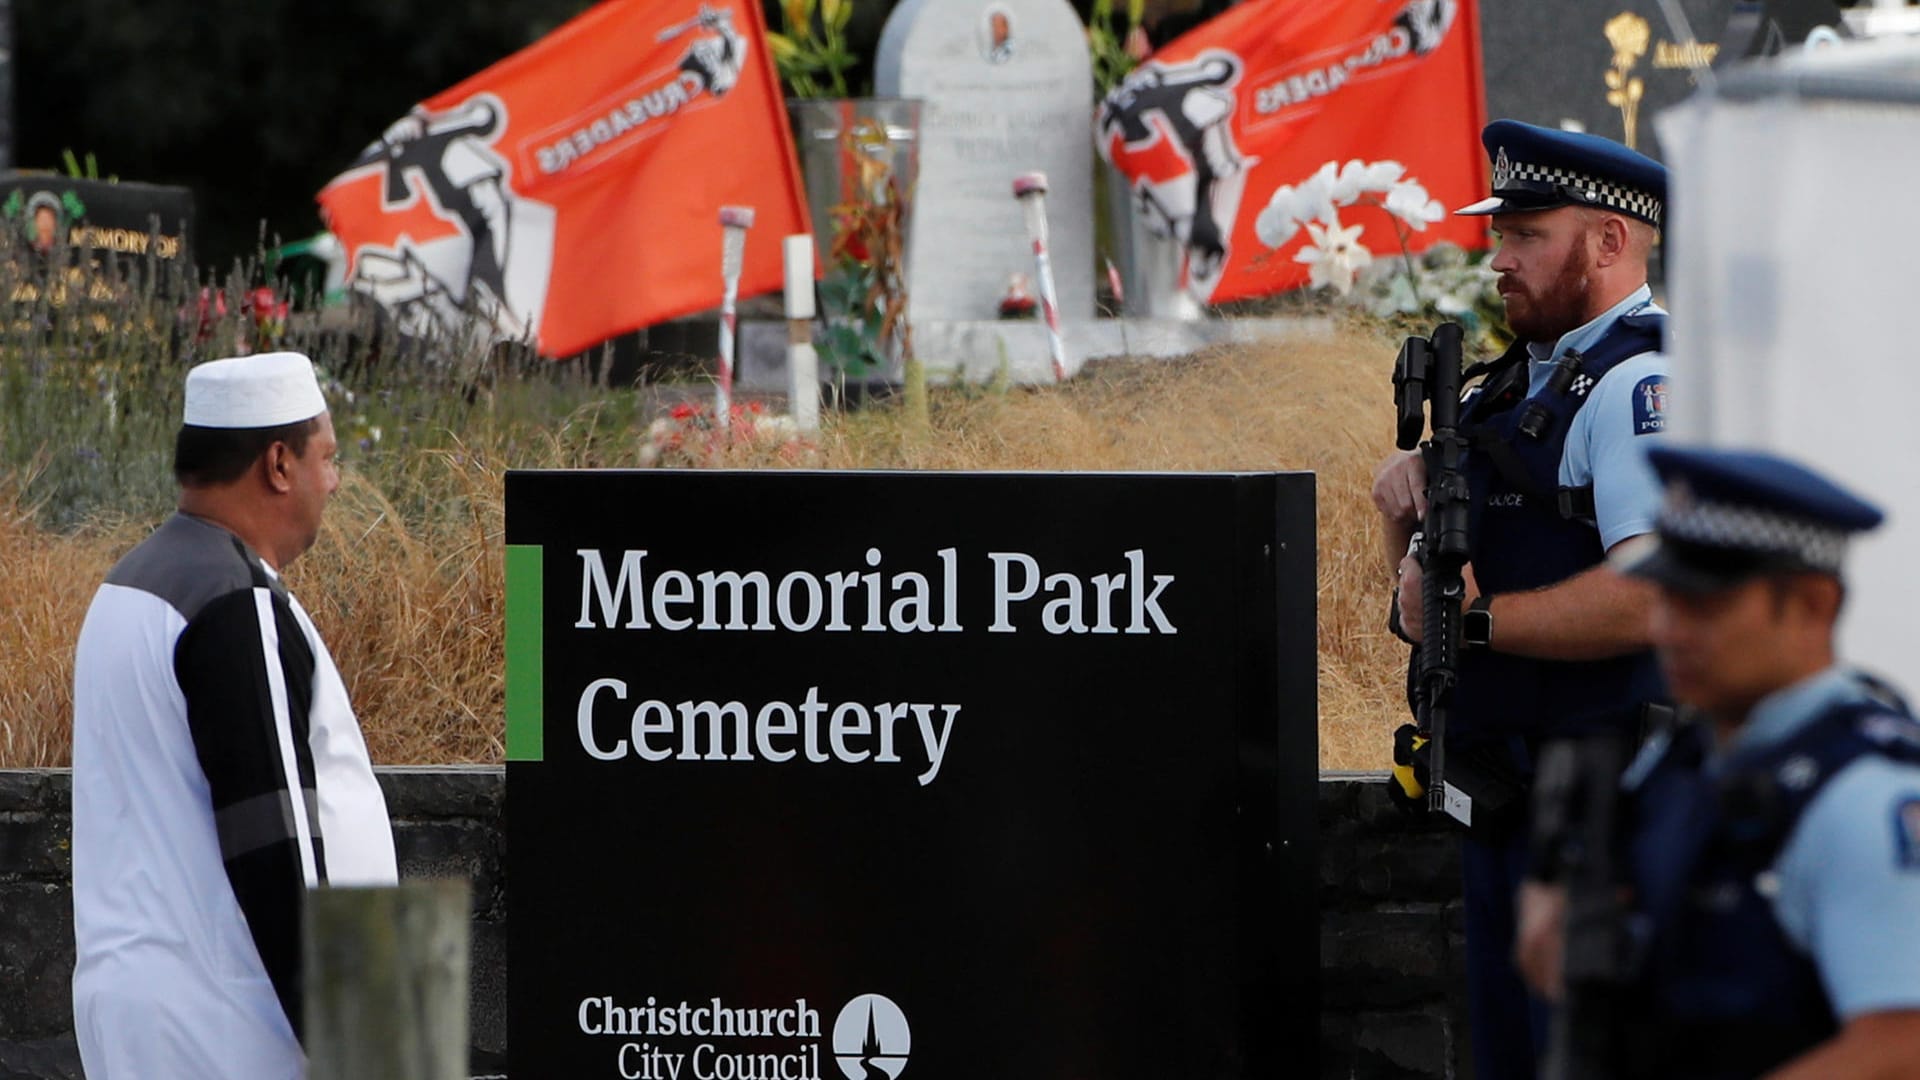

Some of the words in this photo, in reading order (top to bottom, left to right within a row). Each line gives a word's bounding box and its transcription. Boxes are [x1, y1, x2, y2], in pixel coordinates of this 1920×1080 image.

[1488, 493, 1523, 506] OLICE
[575, 547, 963, 633] Memorial
[987, 548, 1178, 635] Park
[577, 677, 962, 787] Cemetery
[578, 996, 822, 1037] Christchurch
[618, 1042, 685, 1080] City
[692, 1043, 822, 1080] Council
